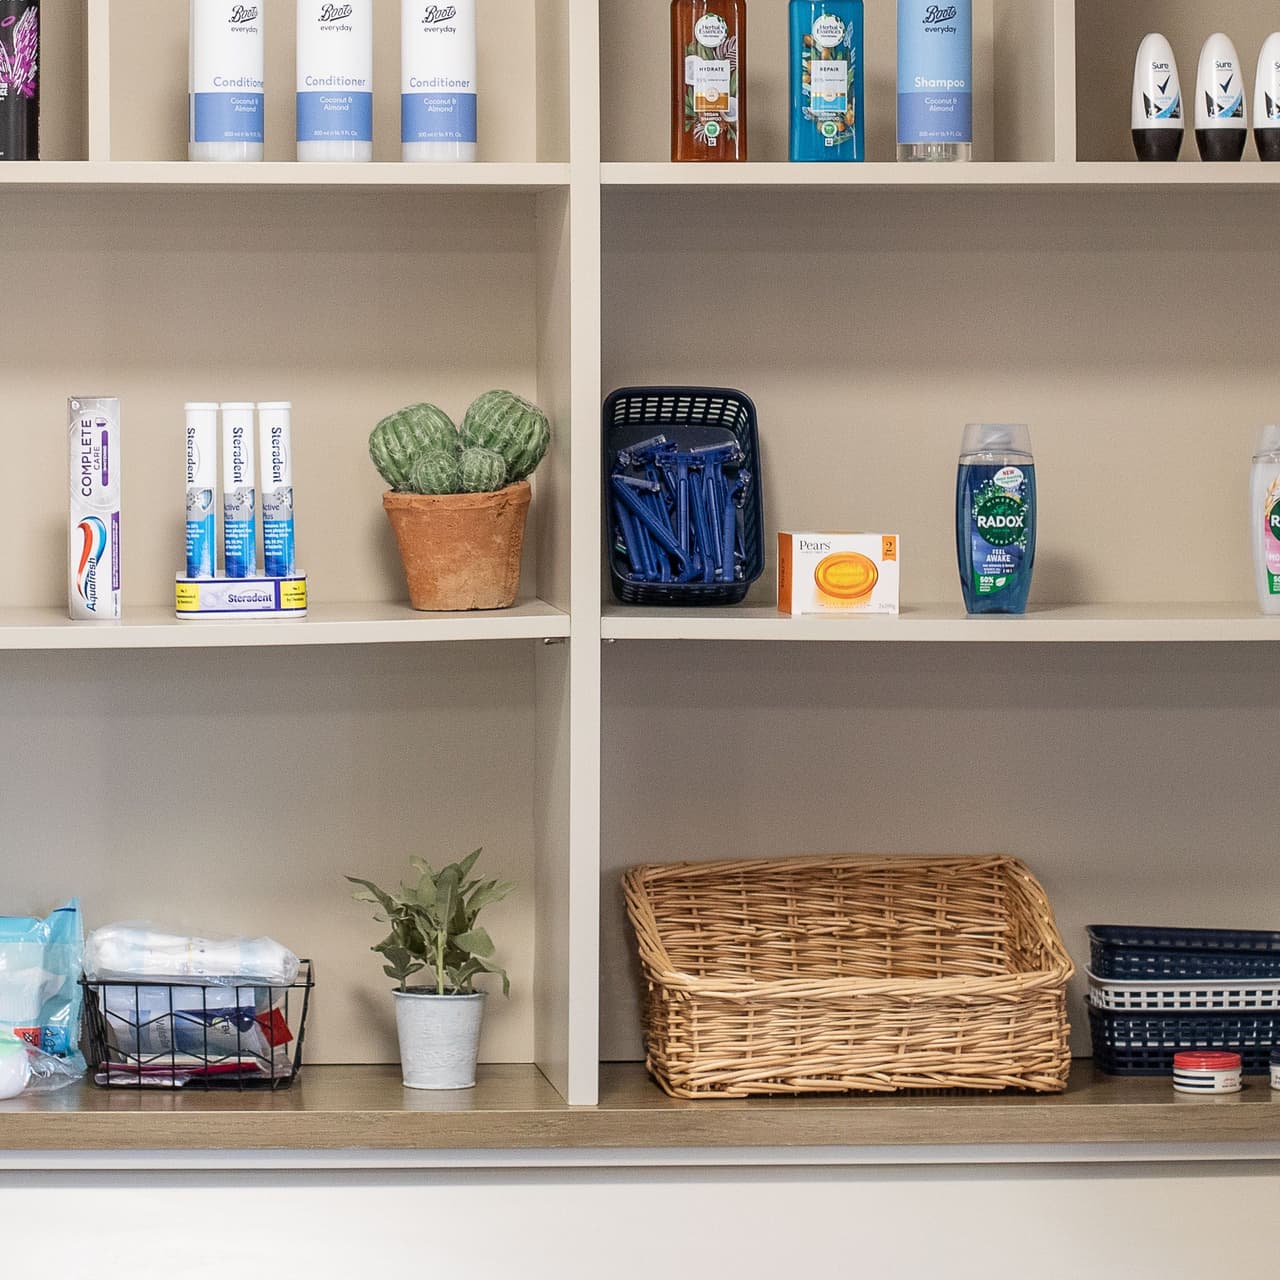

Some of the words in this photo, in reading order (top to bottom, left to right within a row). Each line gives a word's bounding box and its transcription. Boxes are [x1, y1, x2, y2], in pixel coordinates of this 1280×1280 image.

[228, 4, 258, 23] Boots
[317, 3, 353, 22] Boots
[421, 5, 456, 24] Boots
[922, 5, 957, 24] Boots
[230, 25, 258, 34] everyday
[320, 25, 353, 33] everyday
[424, 26, 456, 34] everyday
[924, 25, 957, 34] everyday
[1215, 60, 1232, 68] Sure
[213, 76, 264, 88] Conditione
[305, 75, 366, 87] Conditioner
[409, 76, 470, 89] Conditioner
[914, 76, 966, 90] Shampoo
[319, 95, 346, 104] Coconut
[423, 97, 450, 105] Coconut
[234, 104, 257, 112] Almond
[323, 103, 350, 112] Almond
[427, 105, 453, 113] Almond
[929, 103, 954, 112] Almond
[81, 419, 92, 497] COMPLETE
[93, 447, 101, 471] CARE
[232, 426, 245, 483] Steradent
[271, 426, 284, 483] Steradent
[986, 498, 1018, 507] MINERAL
[977, 516, 1024, 528] RADOX
[800, 540, 831, 551] Pears
[886, 541, 893, 552] 2
[986, 554, 1011, 562] AWAKE
[85, 557, 97, 612] Aquafresh
[227, 593, 273, 603] Steradent
